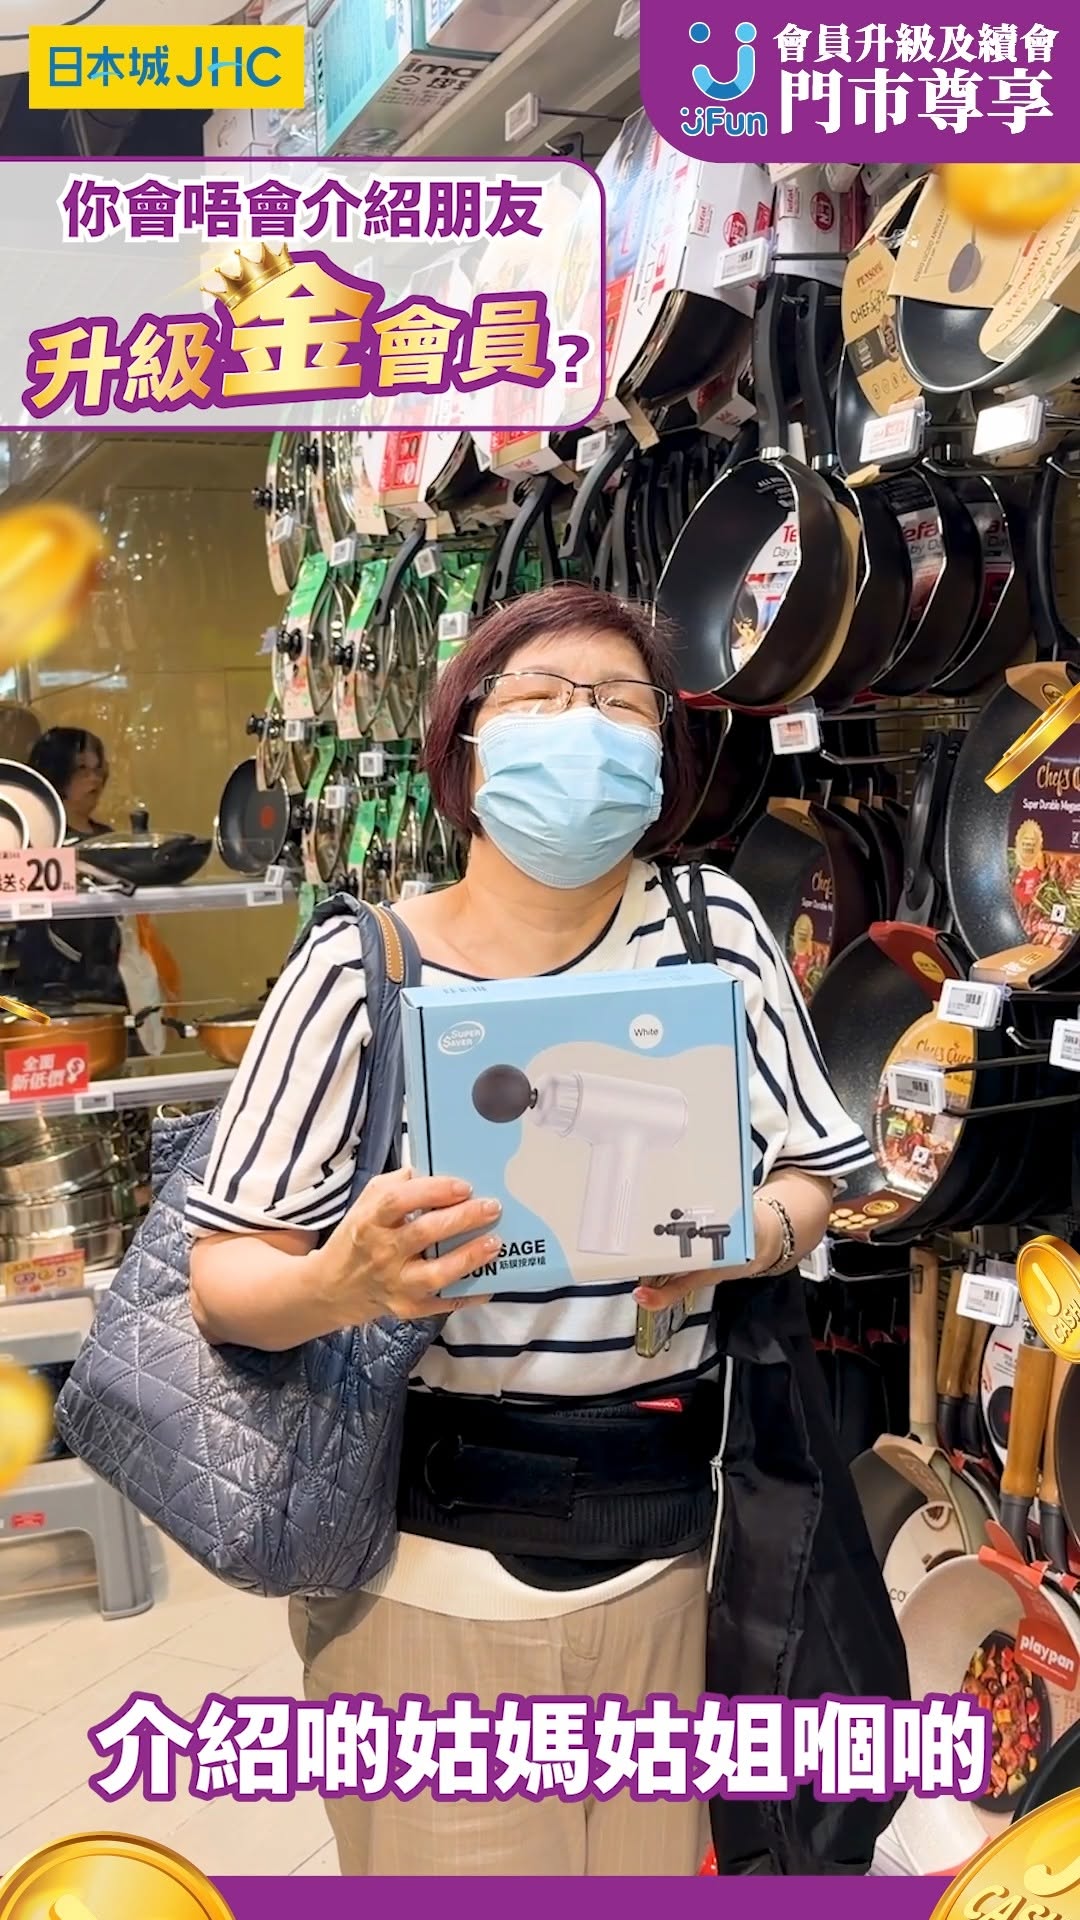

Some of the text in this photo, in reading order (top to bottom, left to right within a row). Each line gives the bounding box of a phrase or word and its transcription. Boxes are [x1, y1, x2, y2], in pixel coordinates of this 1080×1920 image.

[451, 1029, 481, 1039] SUPER
[633, 1027, 659, 1037] White
[442, 1035, 473, 1049] SAVER
[1020, 1634, 1075, 1673] playpan
